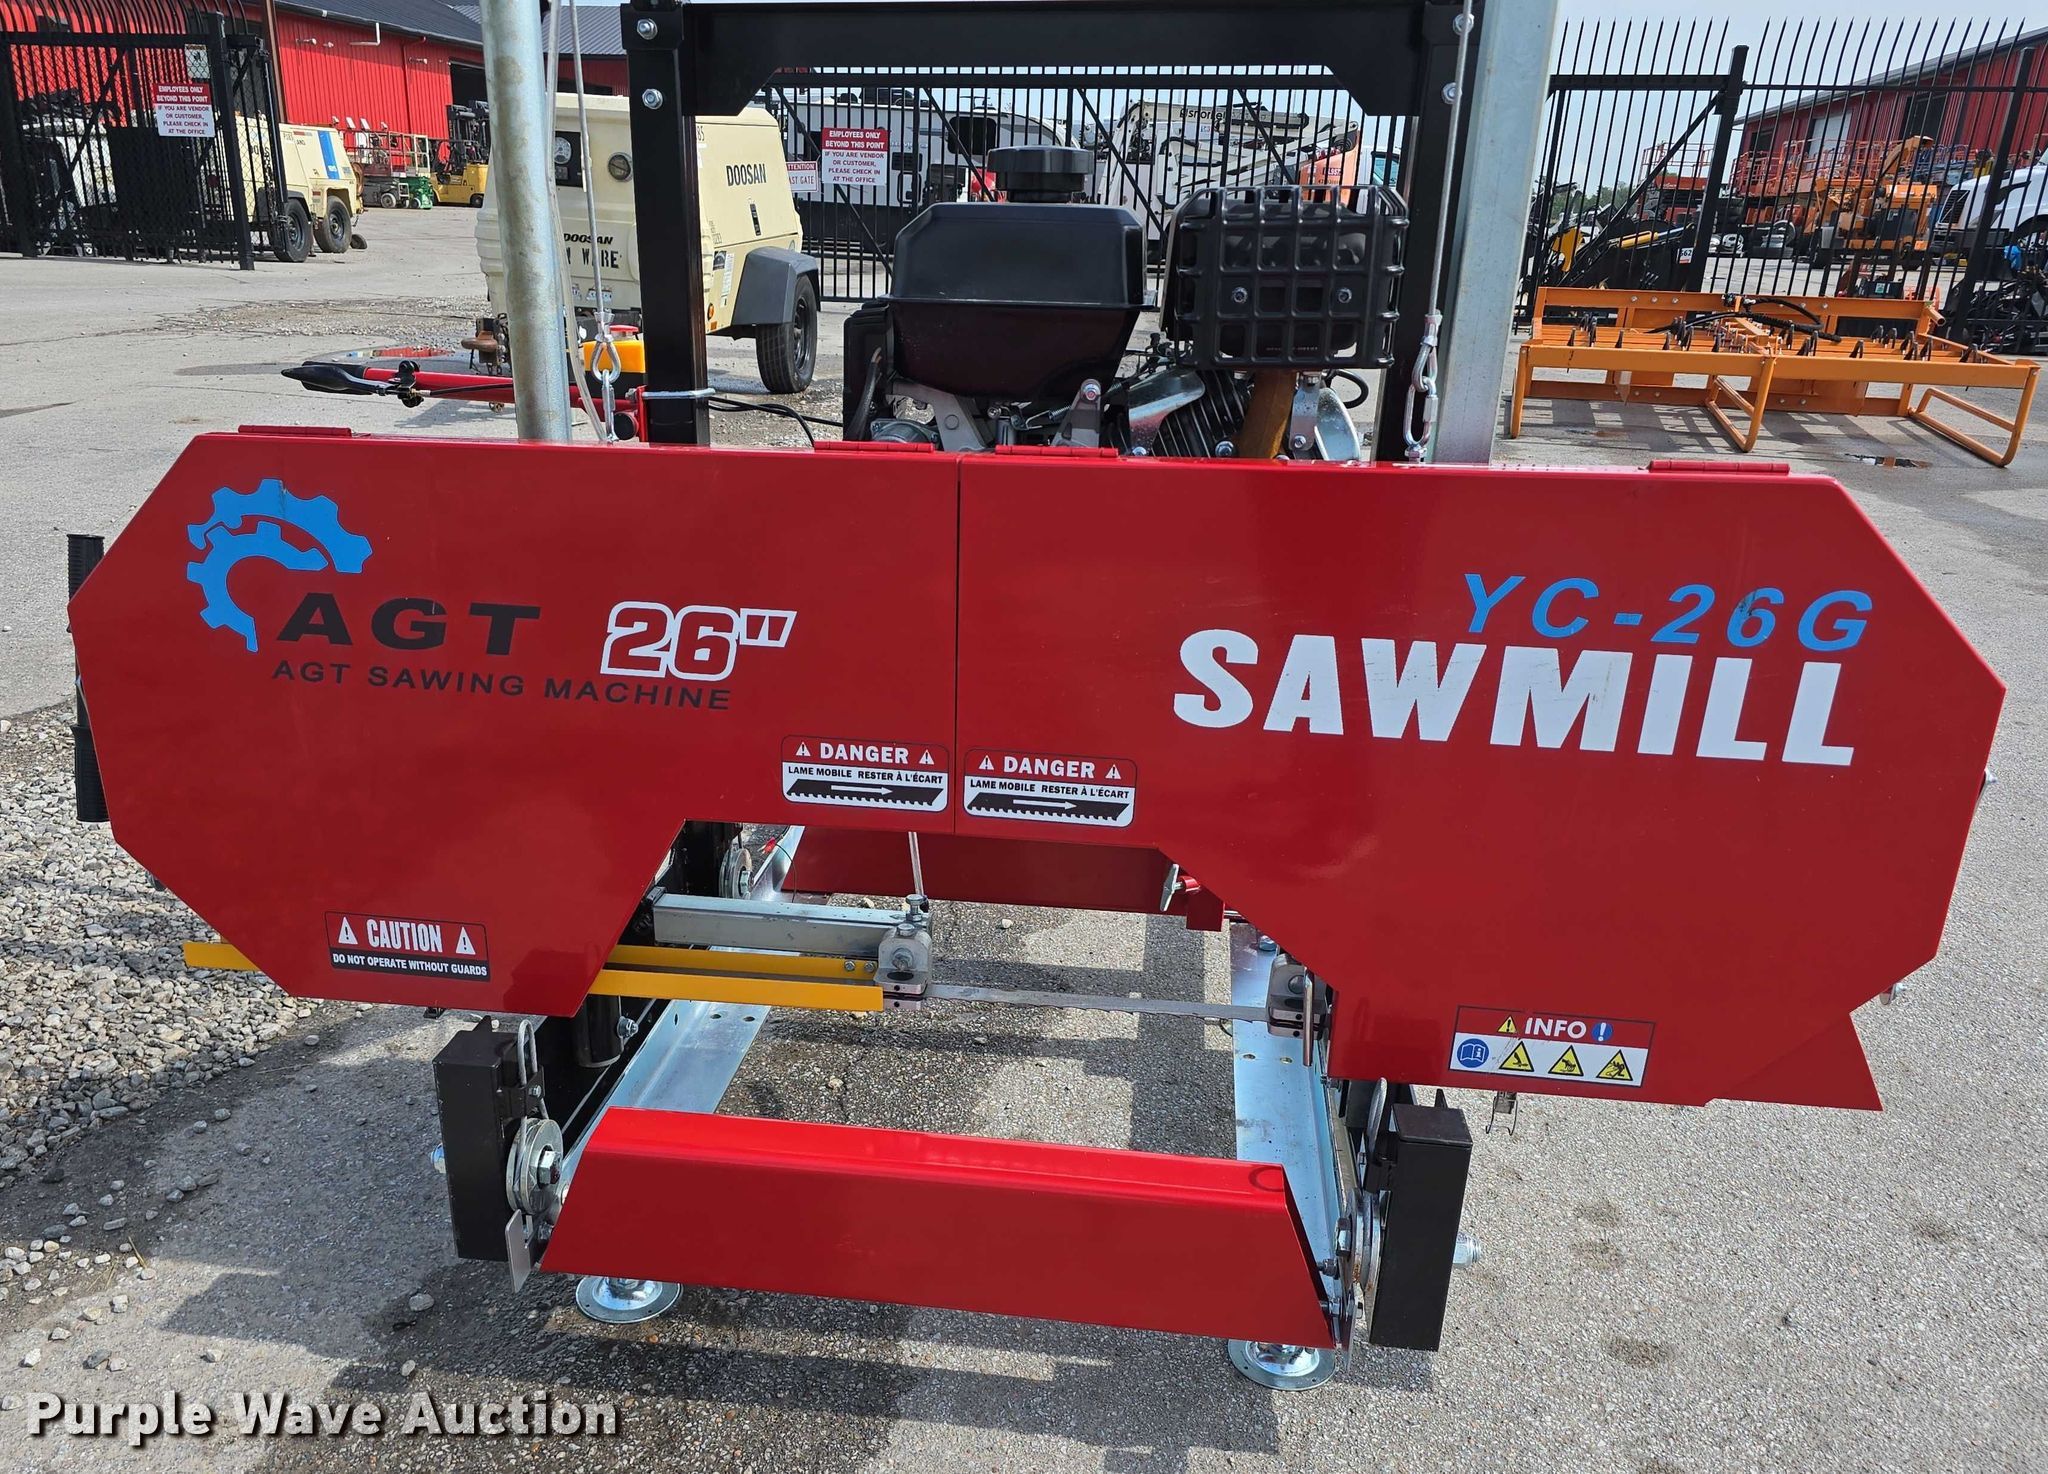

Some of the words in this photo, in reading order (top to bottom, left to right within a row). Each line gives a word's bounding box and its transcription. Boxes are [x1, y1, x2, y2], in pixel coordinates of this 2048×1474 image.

[825, 138, 849, 147] BEYOND
[866, 141, 884, 149] POINT
[829, 130, 864, 139] EMPLOYEES
[866, 131, 881, 139] ONLY
[726, 164, 766, 186] DOOSAN
[800, 176, 814, 184] GATE
[582, 248, 619, 268] WRE
[1464, 573, 1873, 652] YC-26G
[276, 592, 541, 656] AGT
[600, 601, 798, 681] 26"
[272, 660, 351, 685] AGT
[367, 665, 526, 697] SAWING
[543, 679, 731, 710] MACHINE
[1173, 628, 1854, 766] SAWMILL
[820, 742, 909, 764] DANGER
[788, 766, 814, 775] LAME
[816, 768, 852, 778] MOBILE
[858, 771, 893, 781] RESTER
[896, 771, 902, 781] À
[905, 772, 942, 784] L'ÉCART
[1003, 756, 1095, 779] DANGER
[970, 779, 996, 788] LAME
[999, 781, 1035, 792] MOBILE
[1041, 785, 1078, 795] RESTER
[1081, 786, 1088, 796] À
[1090, 787, 1129, 799] L'ÉCART
[366, 919, 443, 953] CAUTION
[333, 953, 345, 964] DO
[348, 954, 365, 965] NOT
[367, 957, 407, 969] OPERATE
[409, 960, 448, 972] WITHOUT
[451, 964, 487, 976] GUARDS
[1524, 1017, 1587, 1039] INFO
